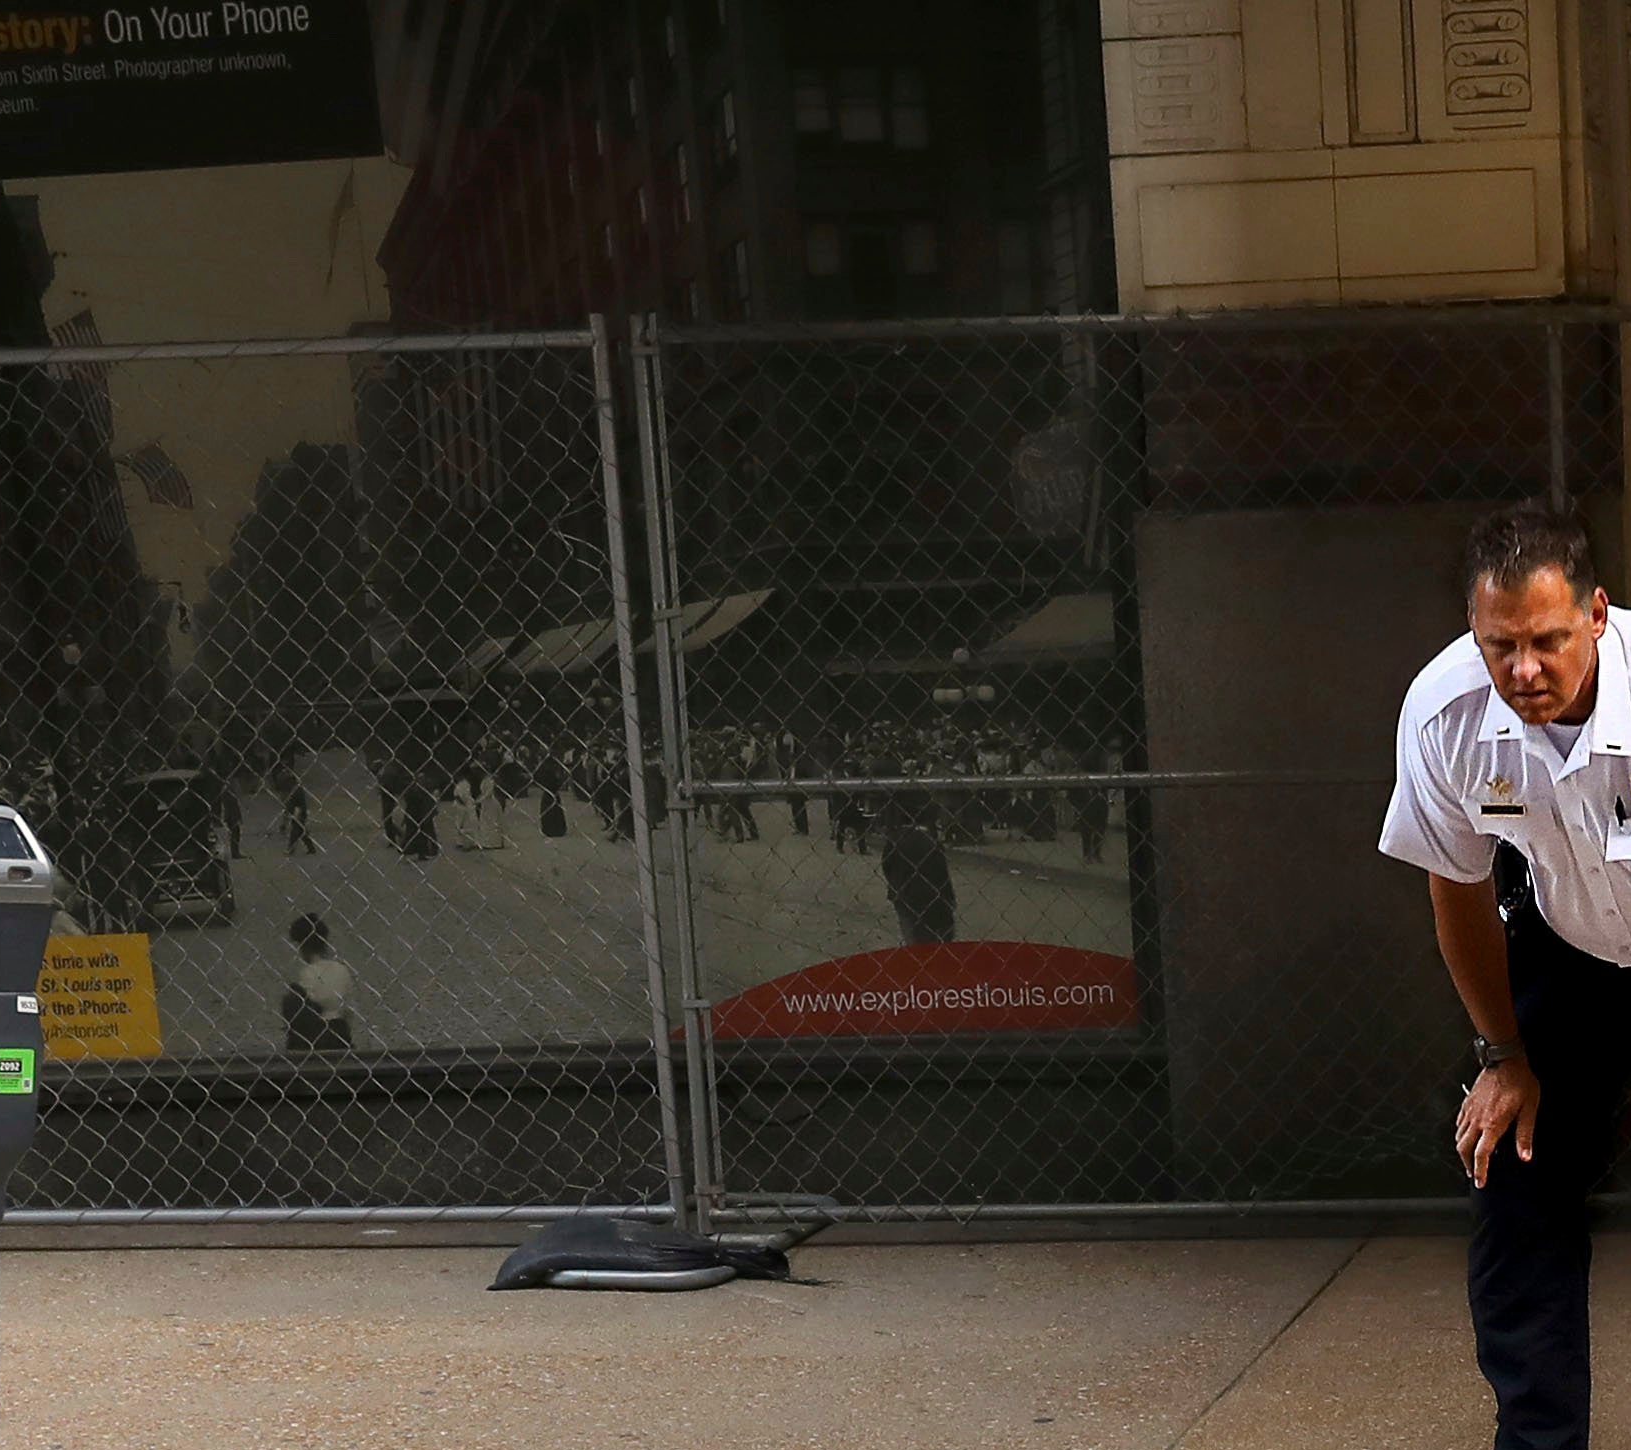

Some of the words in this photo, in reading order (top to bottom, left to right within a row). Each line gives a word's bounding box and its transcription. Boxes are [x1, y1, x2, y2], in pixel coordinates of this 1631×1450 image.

[103, 8, 143, 43] On
[150, 5, 212, 40] Your
[221, 1, 309, 36] Phone
[22, 61, 57, 86] Sixth
[114, 55, 213, 80] Photographer
[52, 954, 85, 969] time
[87, 953, 121, 969] with
[64, 977, 101, 993] Louis
[105, 977, 132, 994] app
[53, 1000, 75, 1016] the
[79, 1000, 132, 1016] iPhone.
[784, 981, 1114, 1015] www.explorestlouis.com
